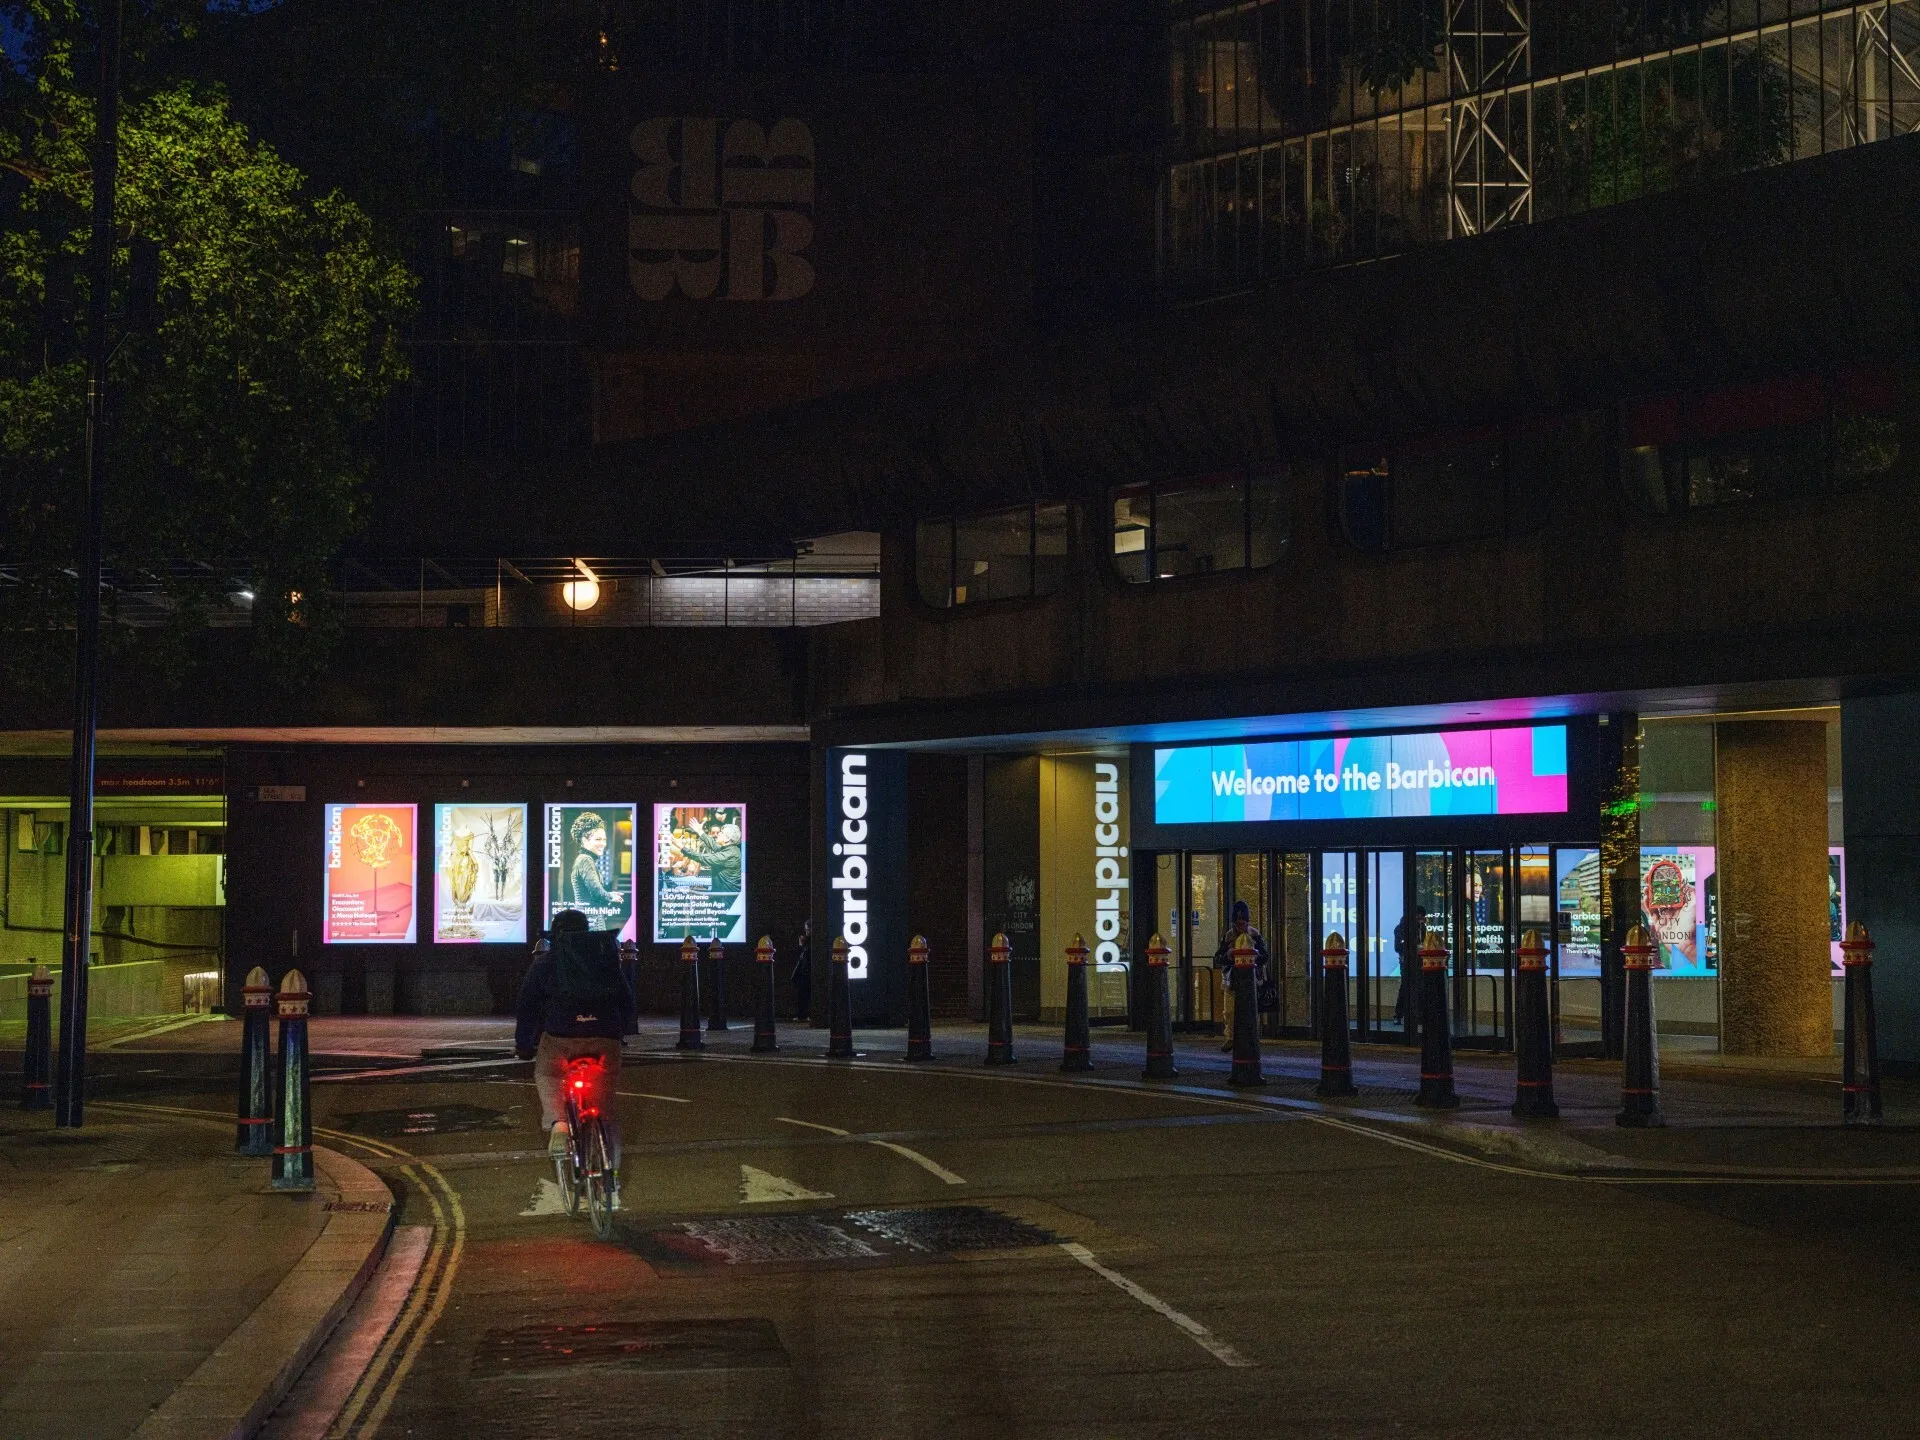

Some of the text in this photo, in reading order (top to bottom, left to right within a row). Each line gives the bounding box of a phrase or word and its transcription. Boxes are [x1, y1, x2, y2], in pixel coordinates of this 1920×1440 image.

[123, 777, 166, 786] headroom
[168, 778, 190, 786] 3.5m
[1211, 759, 1495, 796] Welcome to the Barbican
[328, 807, 342, 869] barbican
[548, 806, 562, 868] barbican
[832, 754, 868, 980] barbican
[599, 907, 622, 917] Night
[1659, 918, 1680, 926] CITY
